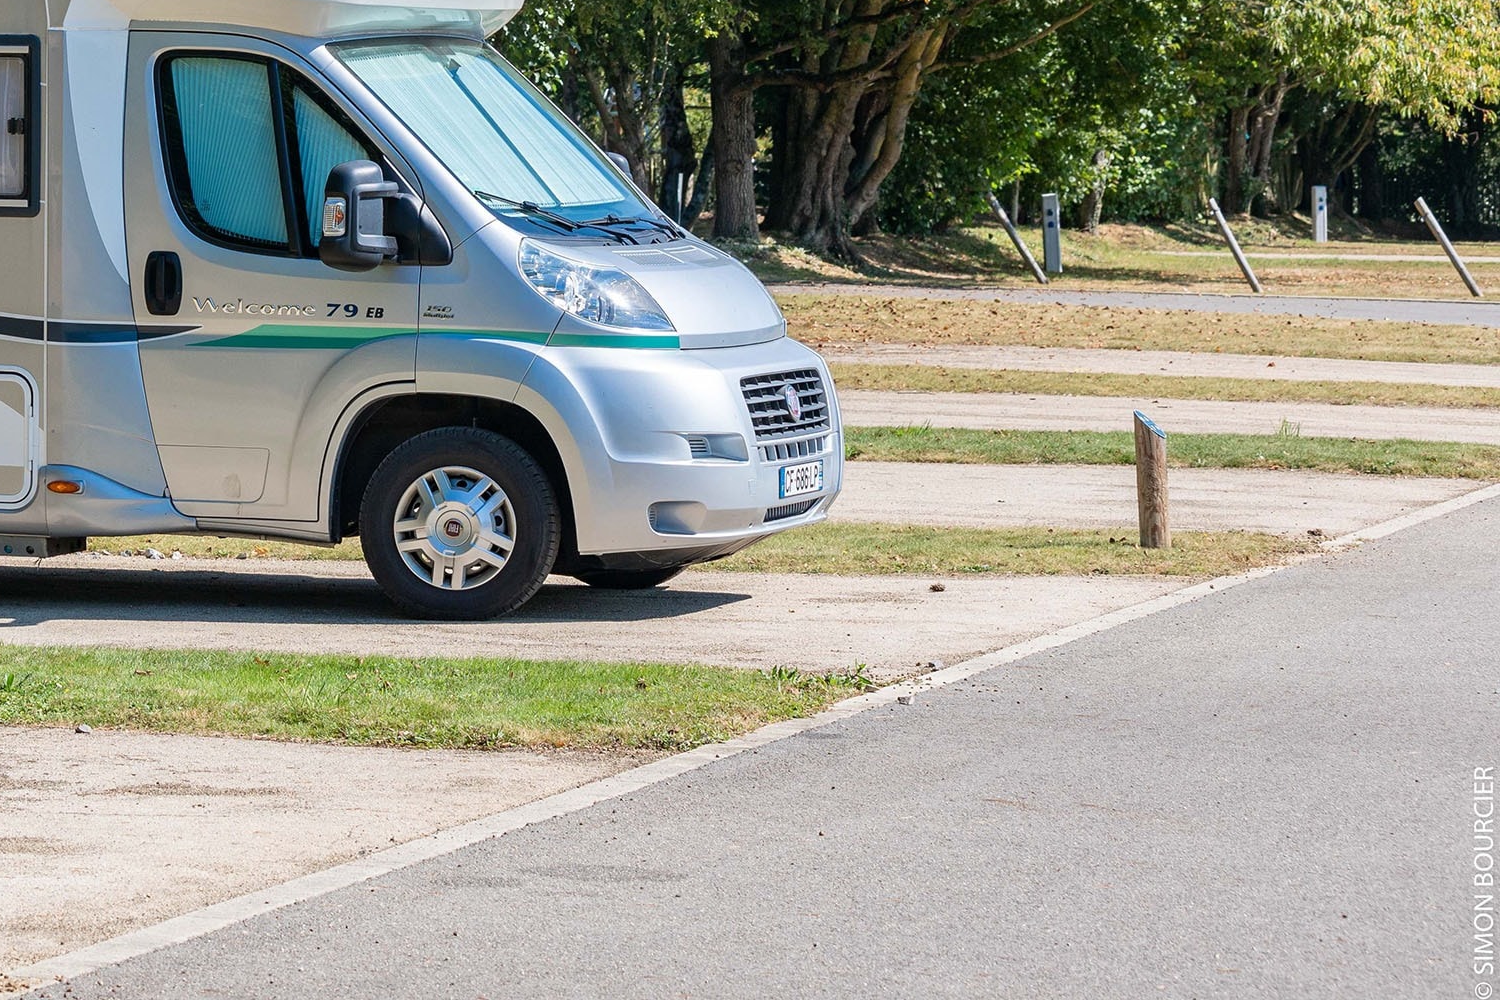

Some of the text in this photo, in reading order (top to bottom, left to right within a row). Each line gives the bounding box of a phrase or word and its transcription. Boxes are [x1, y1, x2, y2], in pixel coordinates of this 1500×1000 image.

[192, 296, 385, 319] Welcome 79 EB
[426, 305, 452, 313] 150
